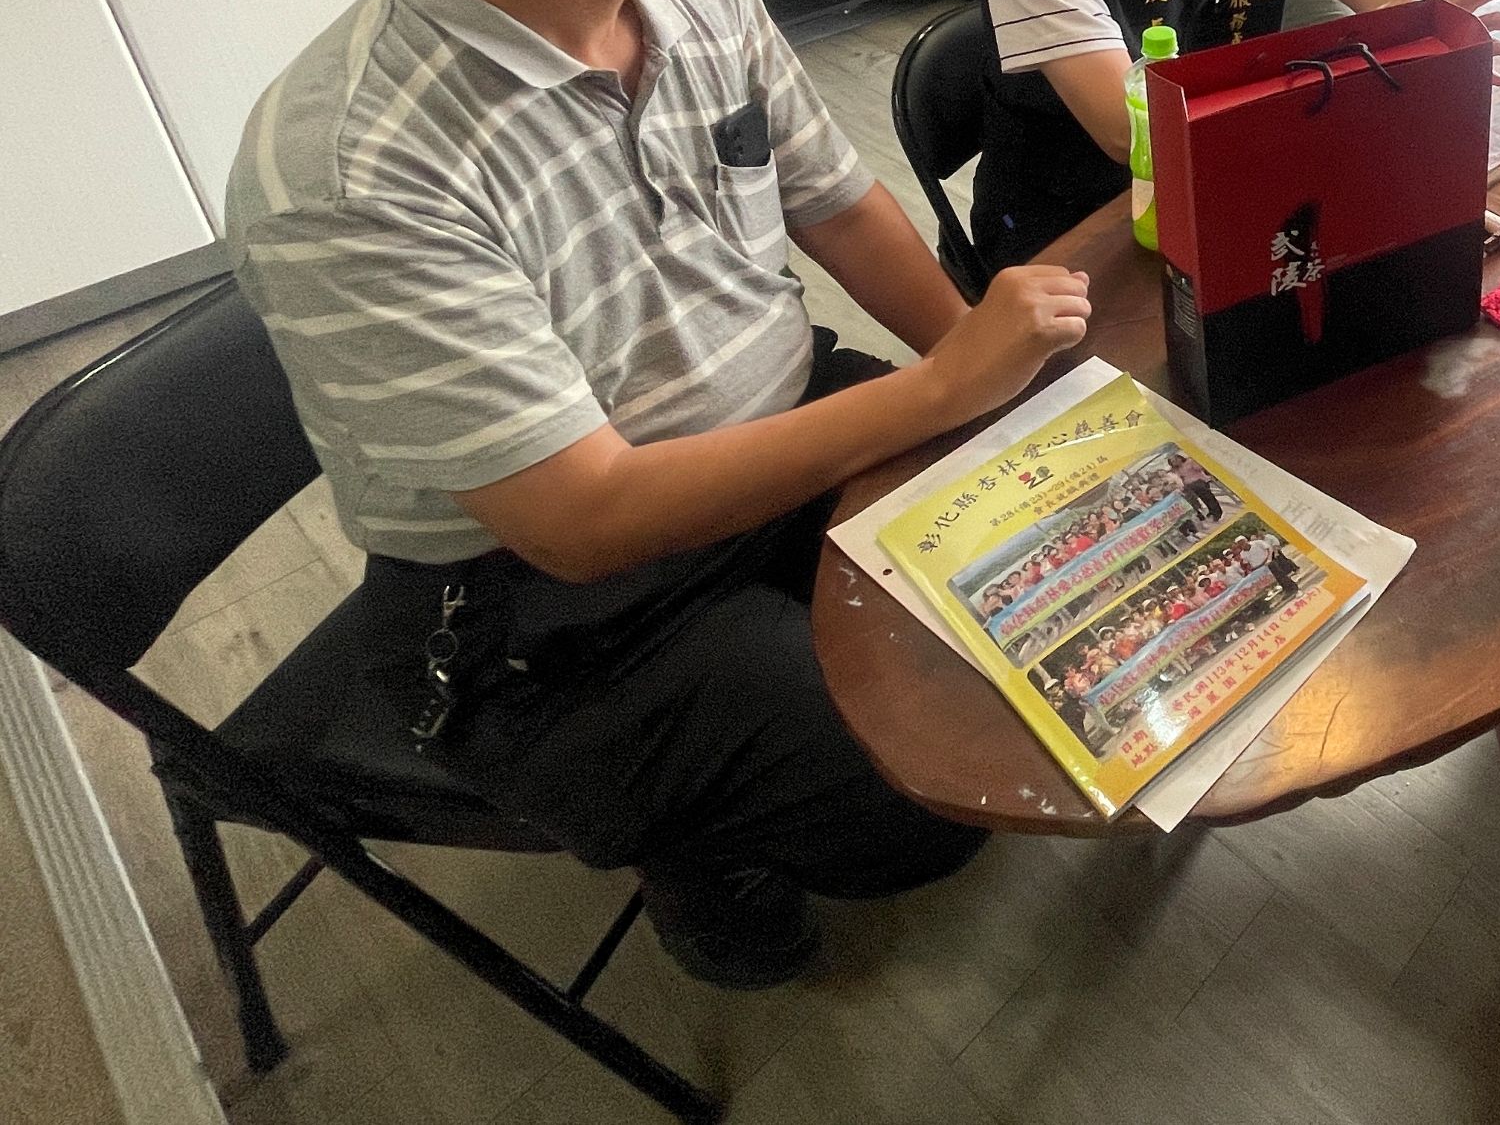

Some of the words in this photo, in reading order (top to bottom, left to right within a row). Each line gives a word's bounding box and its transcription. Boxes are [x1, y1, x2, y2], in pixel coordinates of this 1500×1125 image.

[917, 408, 1144, 554] 彰化縣杏林愛心慈善會
[1120, 728, 1149, 755] 日期
[1131, 742, 1159, 769] 地點
